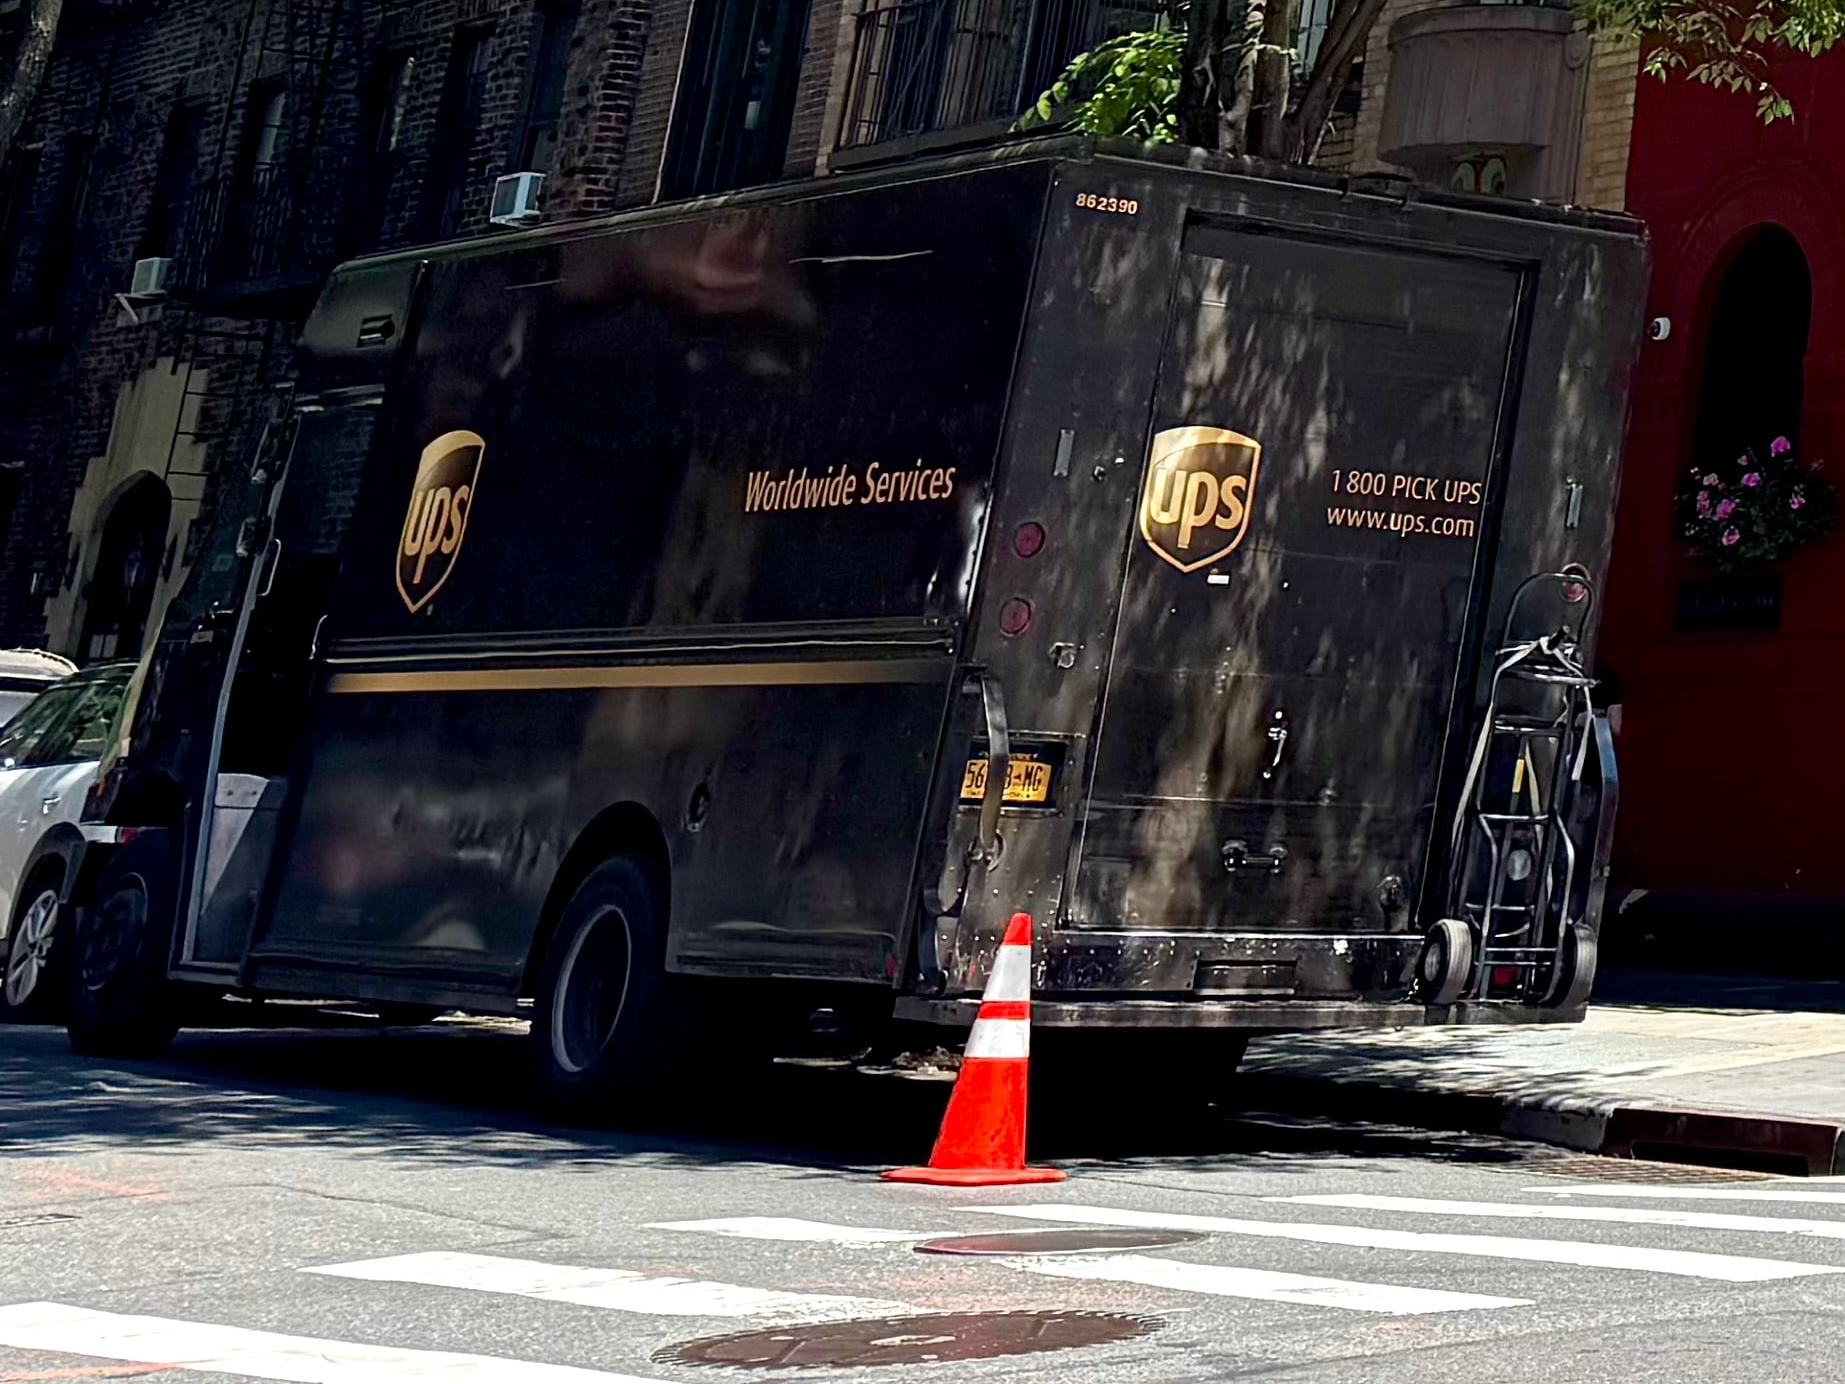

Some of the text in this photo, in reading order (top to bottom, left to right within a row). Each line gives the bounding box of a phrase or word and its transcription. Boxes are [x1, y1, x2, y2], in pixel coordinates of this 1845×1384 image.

[1075, 192, 1138, 215] 862390
[744, 458, 957, 513] Worldwide Services
[1331, 469, 1482, 505] 1 800 PICK UPS
[1150, 467, 1247, 550] ups
[1327, 506, 1475, 538] www.ups.com
[403, 484, 470, 585] ups
